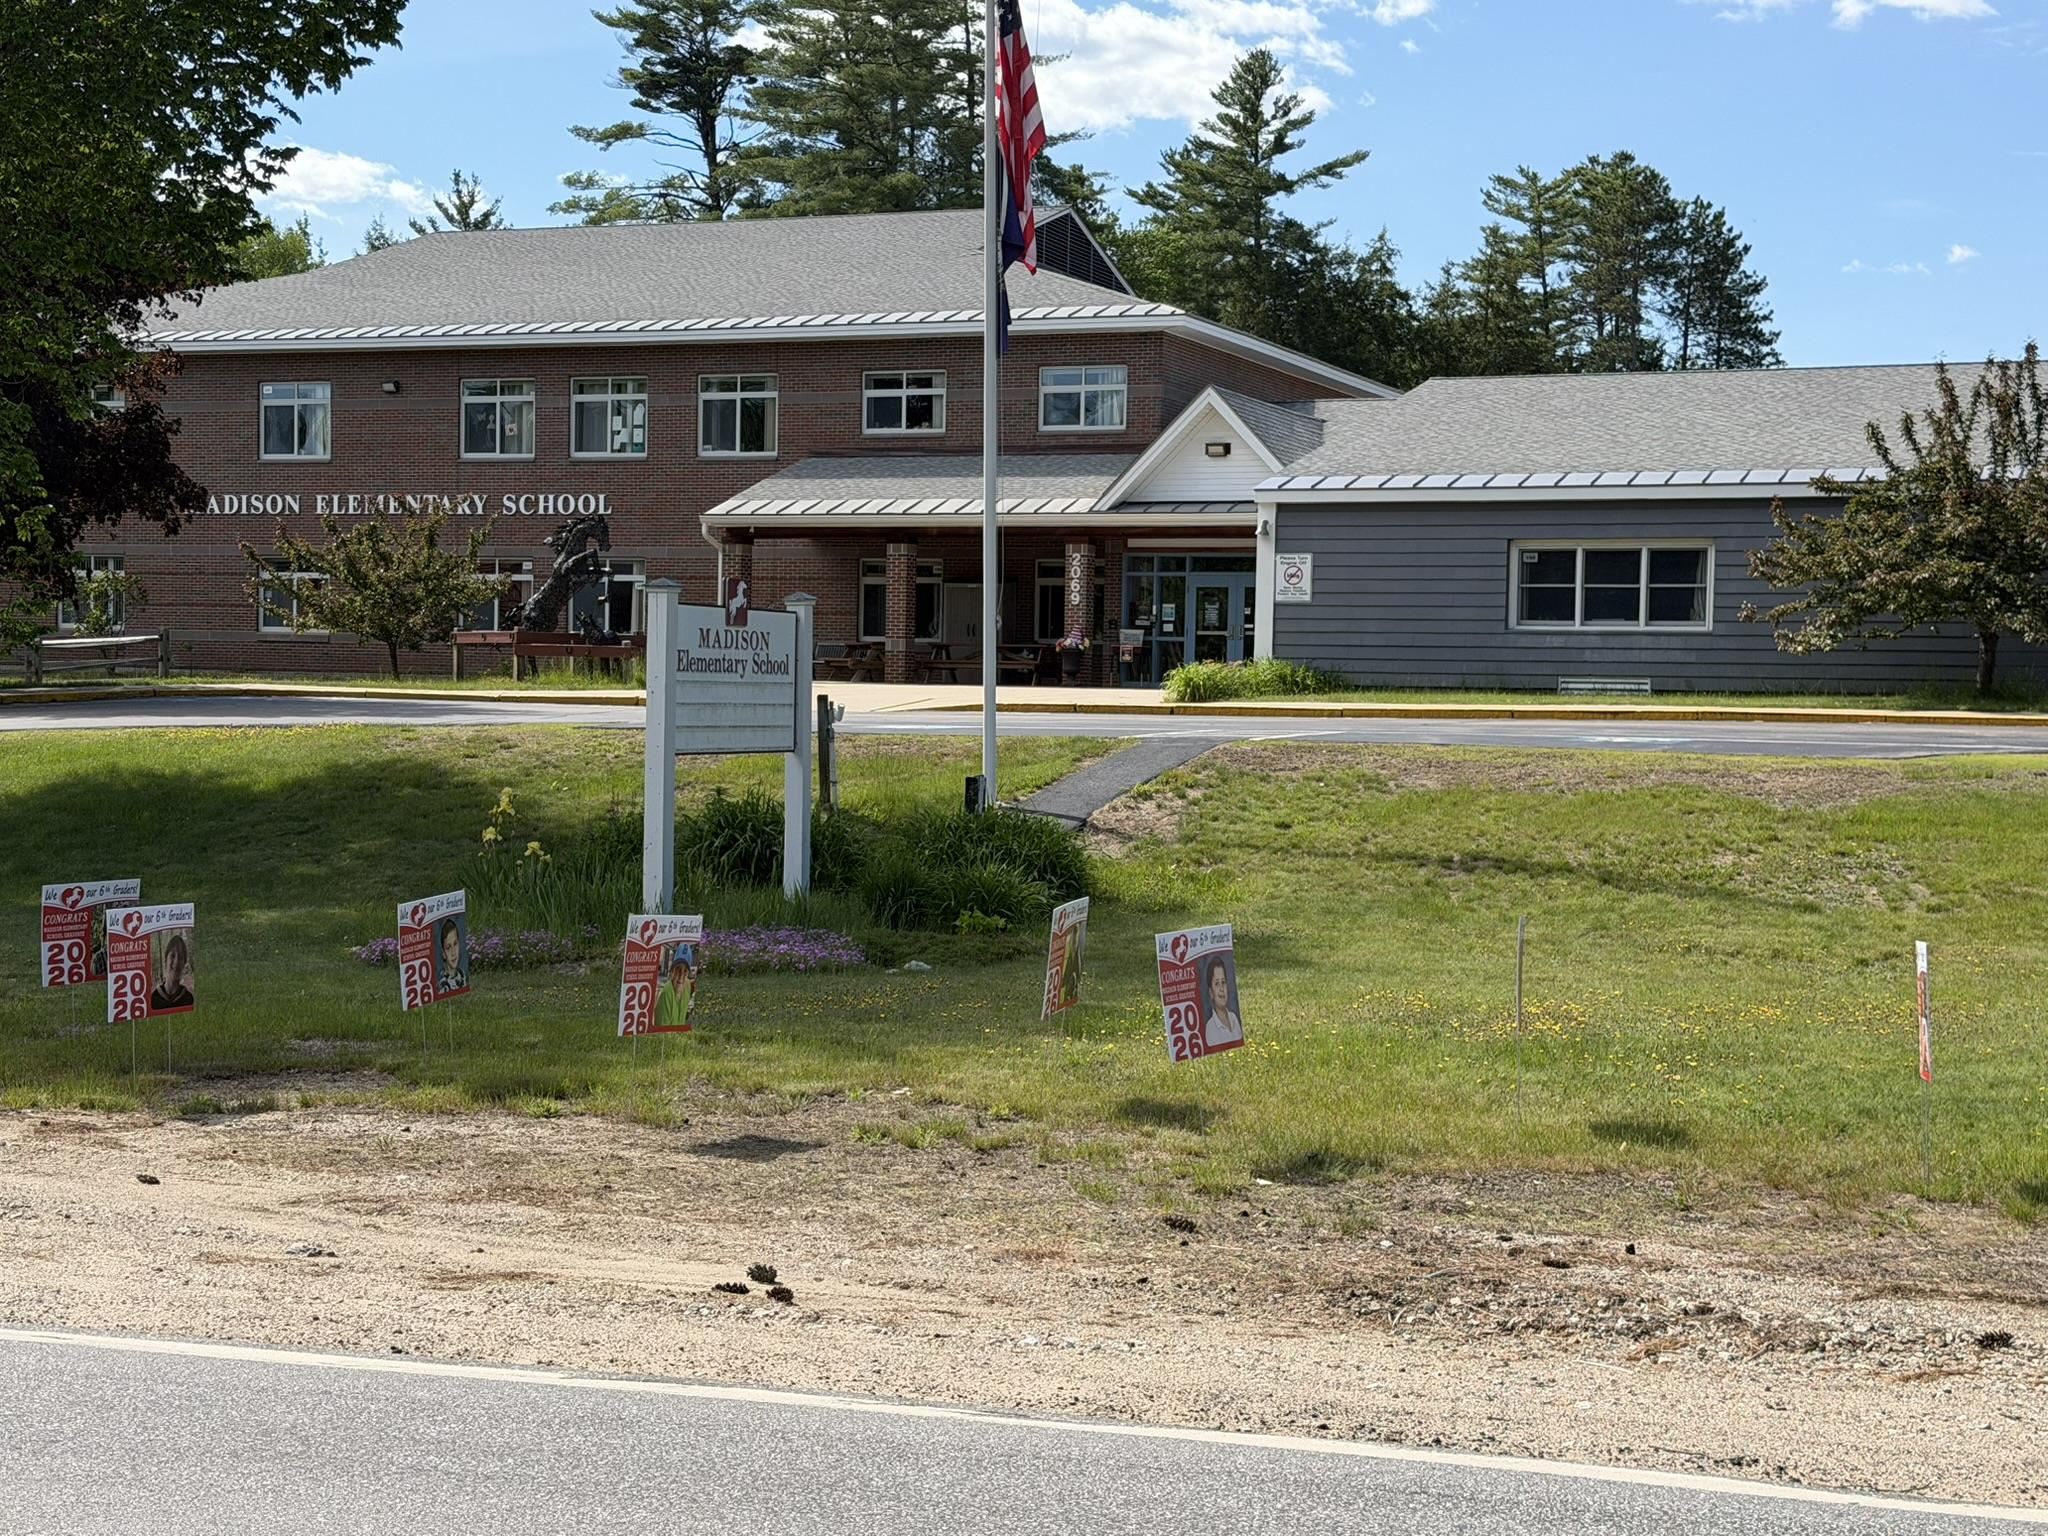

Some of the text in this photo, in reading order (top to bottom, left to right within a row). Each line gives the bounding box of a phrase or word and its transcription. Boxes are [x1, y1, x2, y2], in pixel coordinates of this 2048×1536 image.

[191, 494, 301, 515] ADISON
[502, 493, 613, 516] SCHOOL
[1071, 553, 1081, 605] 2069
[697, 627, 771, 651] MADISON
[676, 649, 789, 679] Elementary School
[45, 888, 58, 901] We
[86, 888, 97, 898] our
[44, 911, 88, 925] CONGRATS
[109, 913, 119, 927] We
[110, 940, 148, 954] CONGRATS
[400, 929, 431, 947] CONGRATS
[47, 941, 85, 965] 20
[627, 950, 658, 964] CONGRATS
[48, 964, 85, 987] 26
[113, 973, 146, 999] 20
[405, 960, 430, 988] 20
[1161, 966, 1196, 985] CONGRATS
[406, 983, 432, 1010] 26
[624, 984, 650, 1011] 20
[113, 997, 146, 1022] 26
[1169, 1003, 1199, 1035] 20
[623, 1011, 648, 1036] 26
[1173, 1032, 1203, 1063] 26
